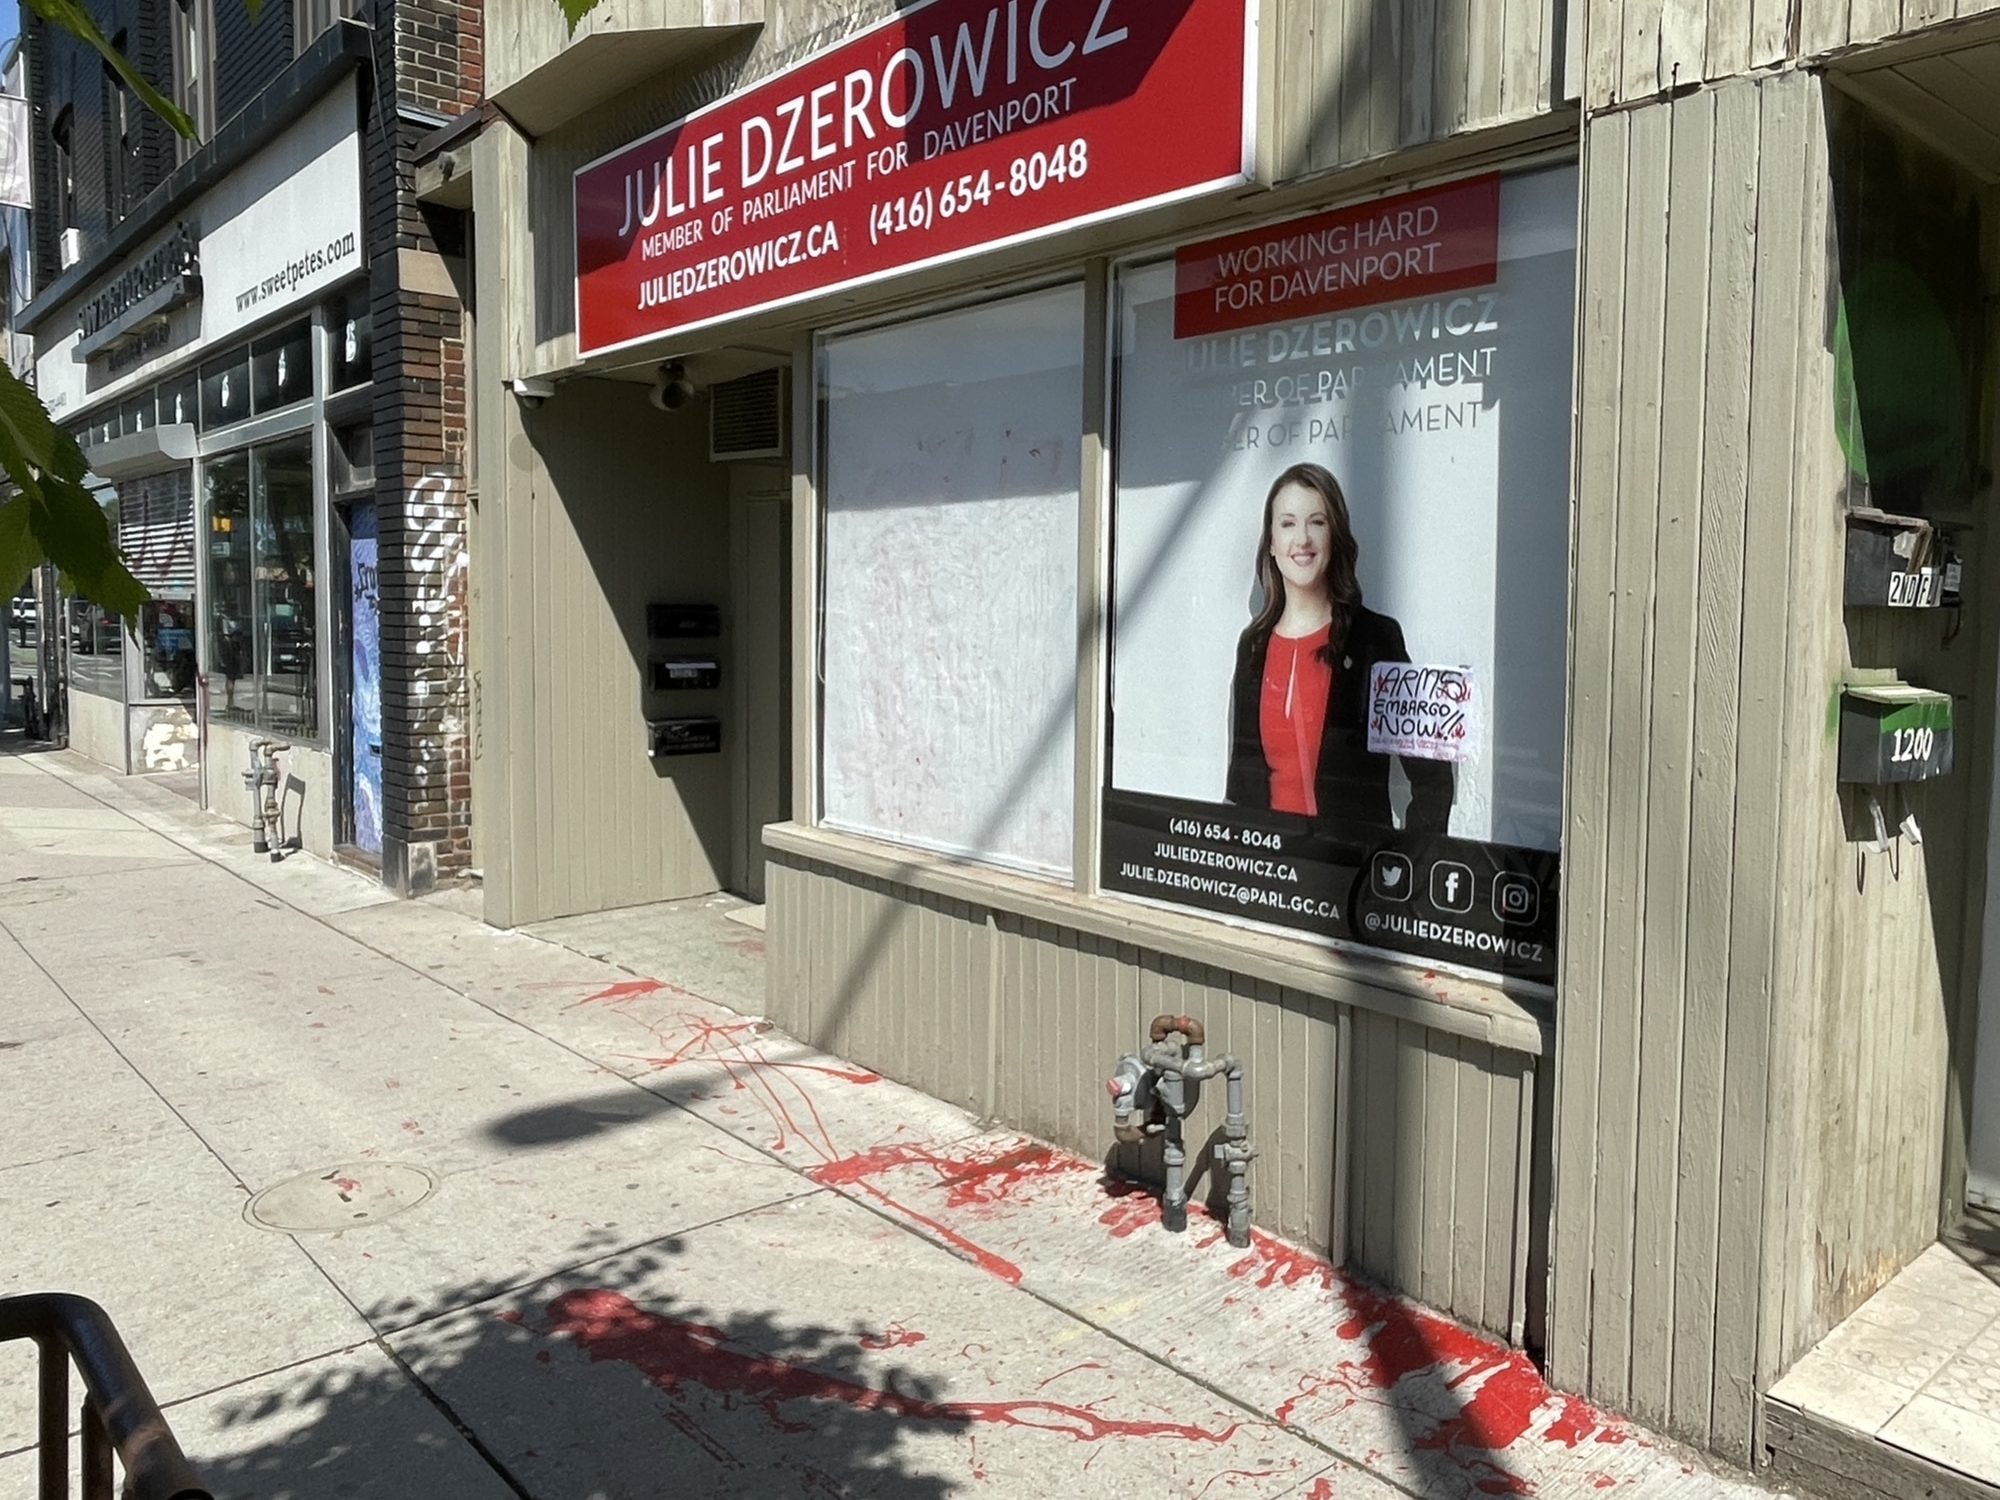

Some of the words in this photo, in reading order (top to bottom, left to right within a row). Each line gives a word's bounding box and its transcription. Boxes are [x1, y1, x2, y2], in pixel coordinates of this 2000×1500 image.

[618, 130, 724, 237] JULIE
[740, 0, 1128, 188] DZEROWICZ
[642, 219, 703, 261] MEMBER
[711, 206, 733, 236] OF
[743, 160, 856, 224] PARLIAMENT
[867, 141, 909, 181] FOR
[924, 77, 1077, 161] DAVENPORT
[637, 220, 839, 310] JULIEDZEROWICZ.CA
[869, 186, 933, 246] (416)
[1217, 225, 1347, 279] WORKING
[1354, 205, 1438, 250] HARD
[236, 231, 355, 312] www.sweetpetes.com
[1215, 279, 1264, 313] FOR
[1270, 242, 1442, 303] DAVENPORT
[1184, 333, 1257, 373] ULIE
[1267, 293, 1499, 364] DZEROWICZ
[1275, 373, 1310, 401] OF
[1889, 574, 1917, 604] 2ND
[1374, 699, 1451, 717] EMBARGO
[1375, 667, 1463, 701] ARMS
[1891, 728, 1934, 762] 1200
[1169, 818, 1201, 838] (416)
[1204, 824, 1231, 842] 654
[1241, 830, 1282, 850] 8048
[1154, 842, 1298, 882] JULIEDZEROWICZ.CA
[1120, 863, 1340, 920] JULIE.DZEROWICZ@PARL.GC.CA
[1365, 912, 1543, 962] @JULIEDZEROWICZ
